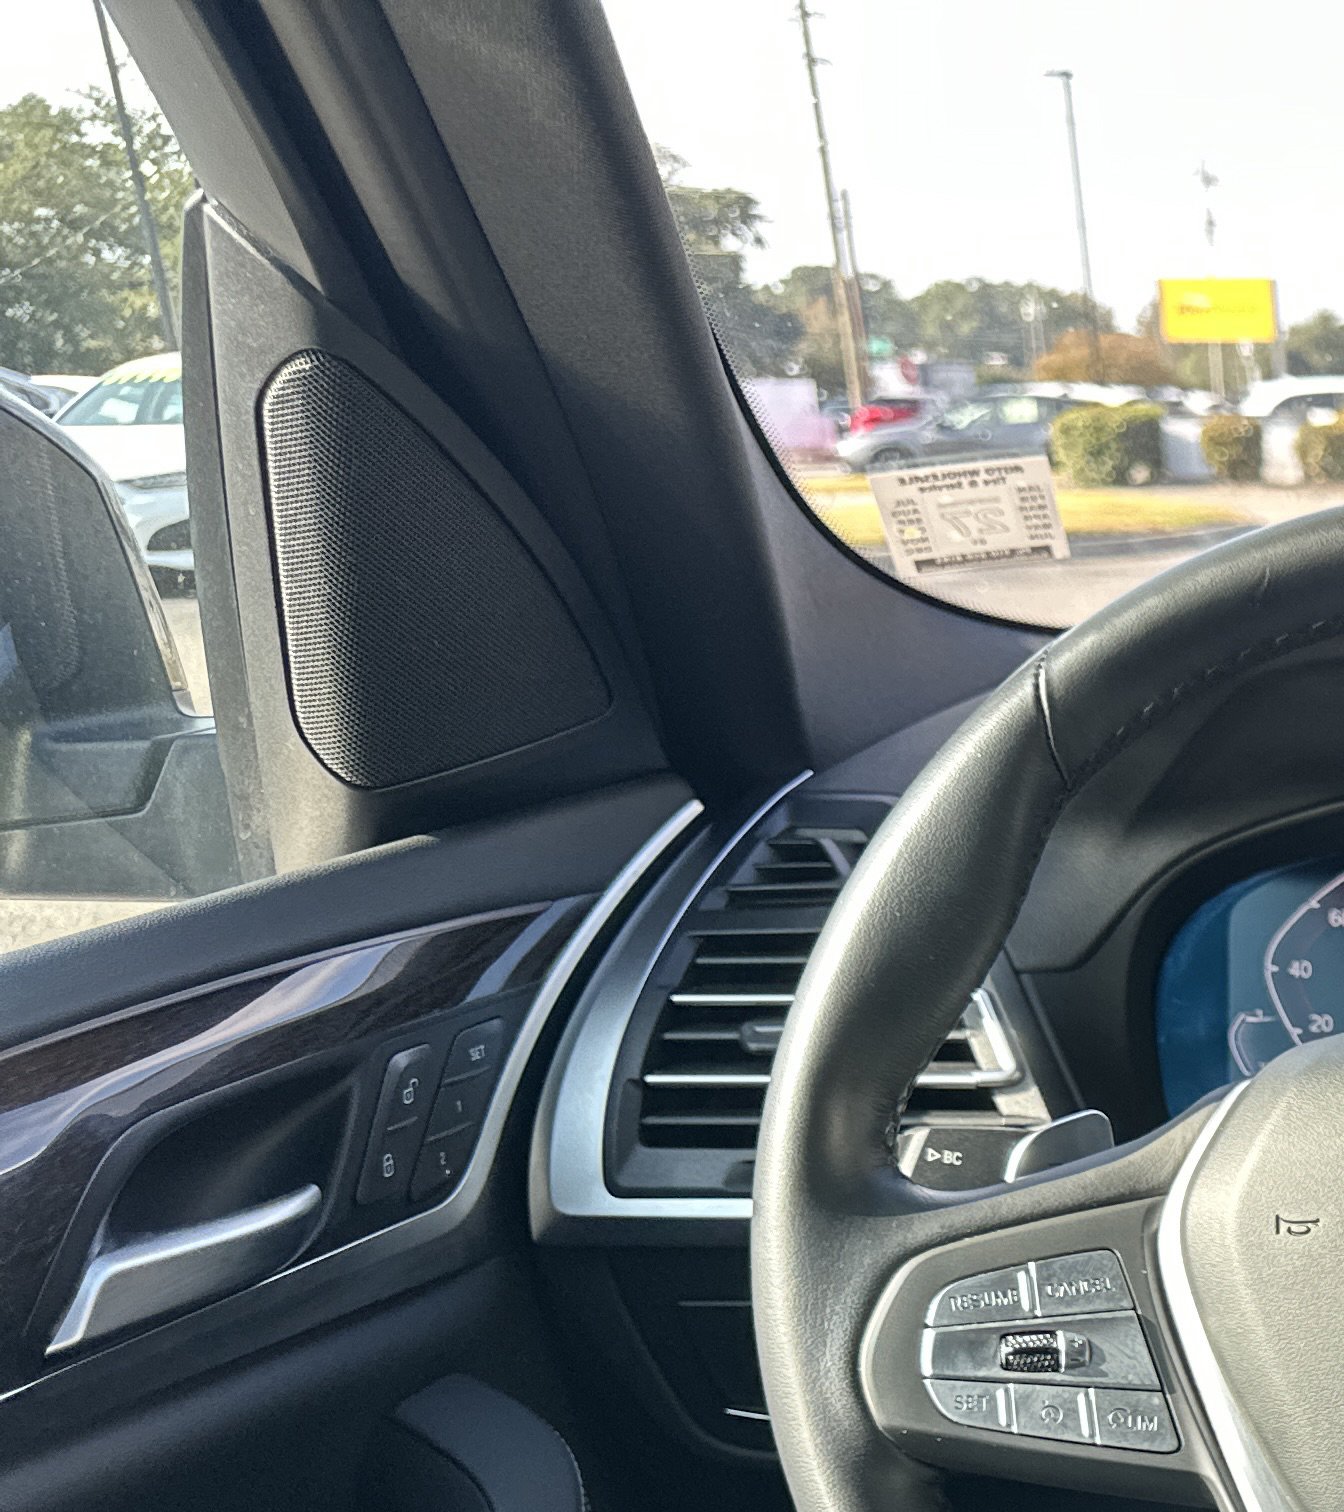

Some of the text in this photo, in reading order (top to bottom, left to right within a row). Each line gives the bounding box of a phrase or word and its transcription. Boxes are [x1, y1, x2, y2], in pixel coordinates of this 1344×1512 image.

[1287, 959, 1313, 979] 40
[1307, 1013, 1335, 1033] 20
[942, 1150, 963, 1166] BC
[1046, 1276, 1116, 1299] CANCEL
[953, 1394, 991, 1414] SET
